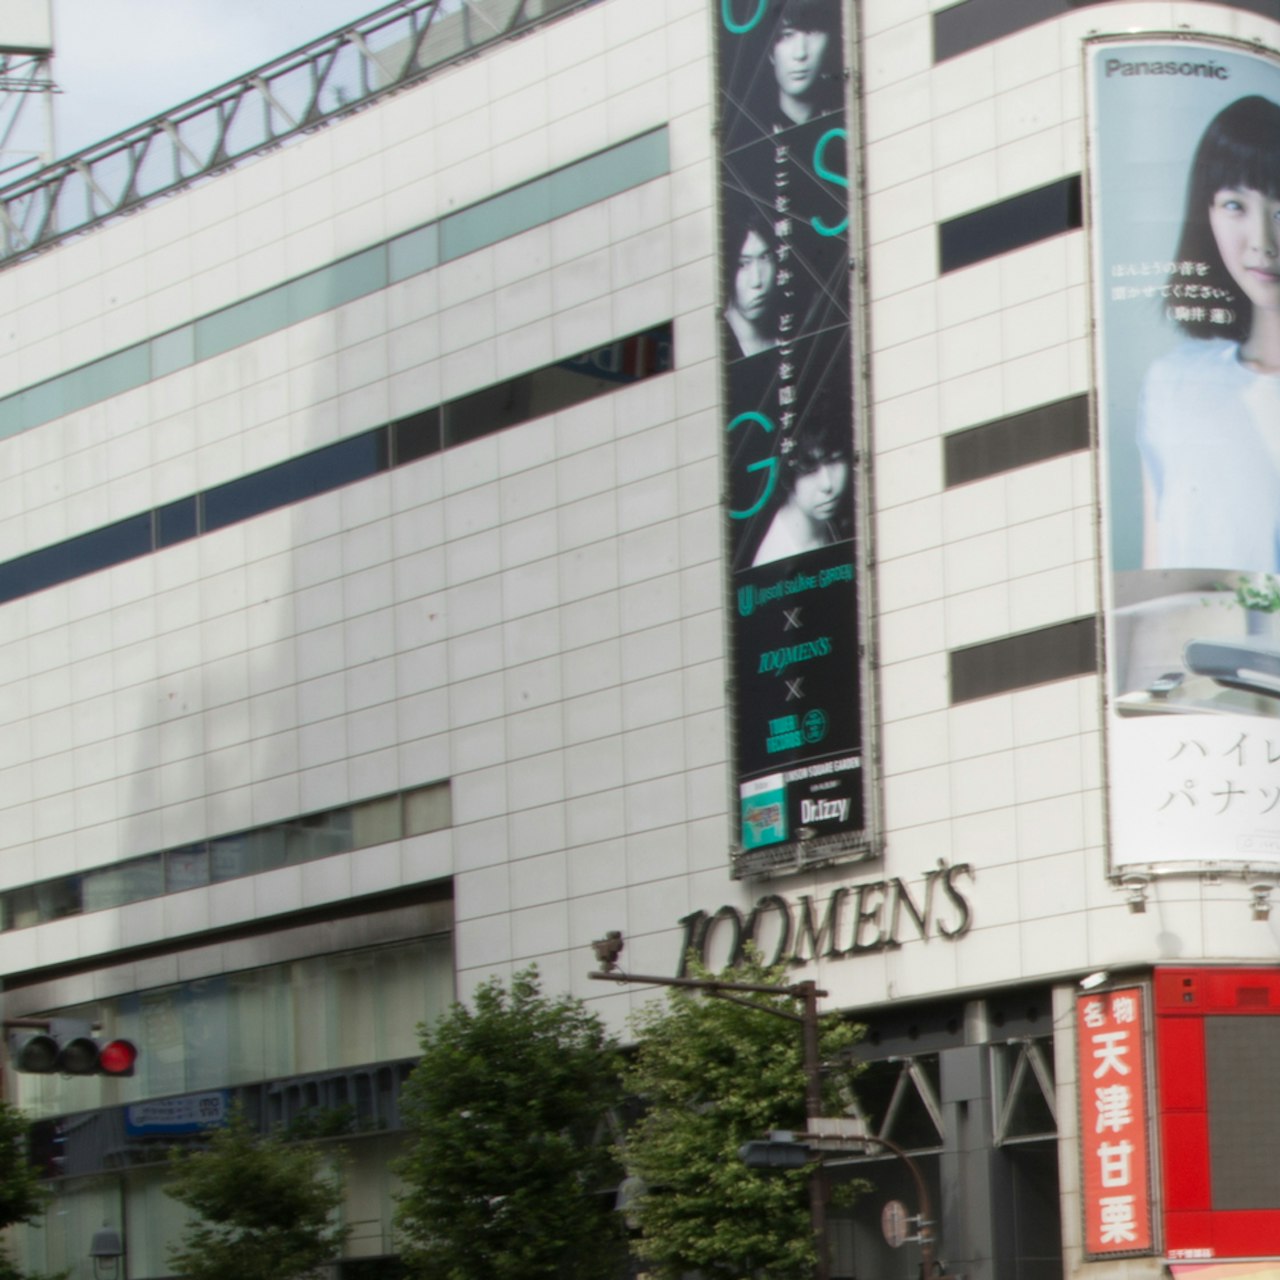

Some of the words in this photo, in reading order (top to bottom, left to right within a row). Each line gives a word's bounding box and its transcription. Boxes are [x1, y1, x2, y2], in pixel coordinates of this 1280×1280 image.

[1105, 58, 1229, 80] Panasonic
[801, 797, 850, 825] Dr.Izzy
[1083, 996, 1136, 1029] 名物
[1091, 1031, 1138, 1244] 天津甘栗
